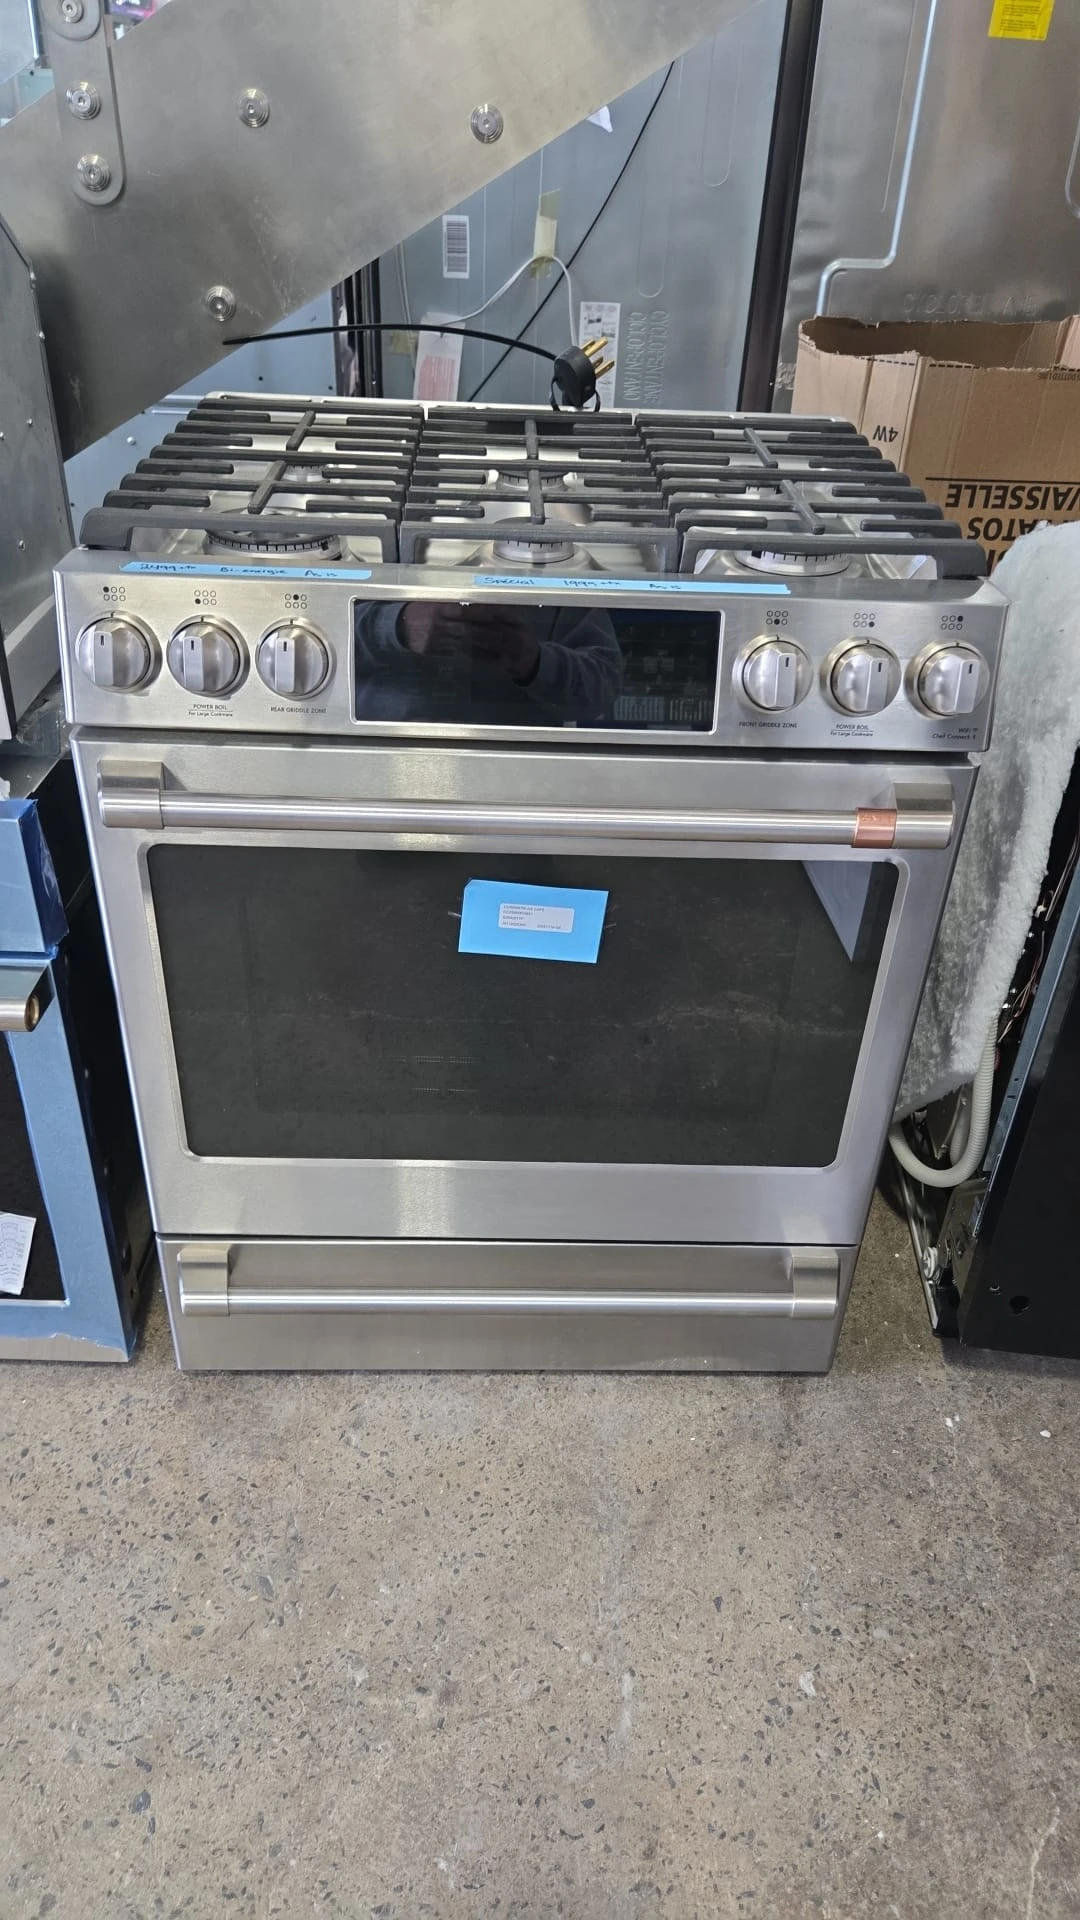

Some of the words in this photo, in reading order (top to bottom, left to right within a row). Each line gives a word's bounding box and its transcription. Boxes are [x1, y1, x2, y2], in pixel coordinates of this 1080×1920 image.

[873, 424, 898, 443] 4W
[270, 705, 285, 713] REAR
[285, 706, 310, 714] GRIDDLE
